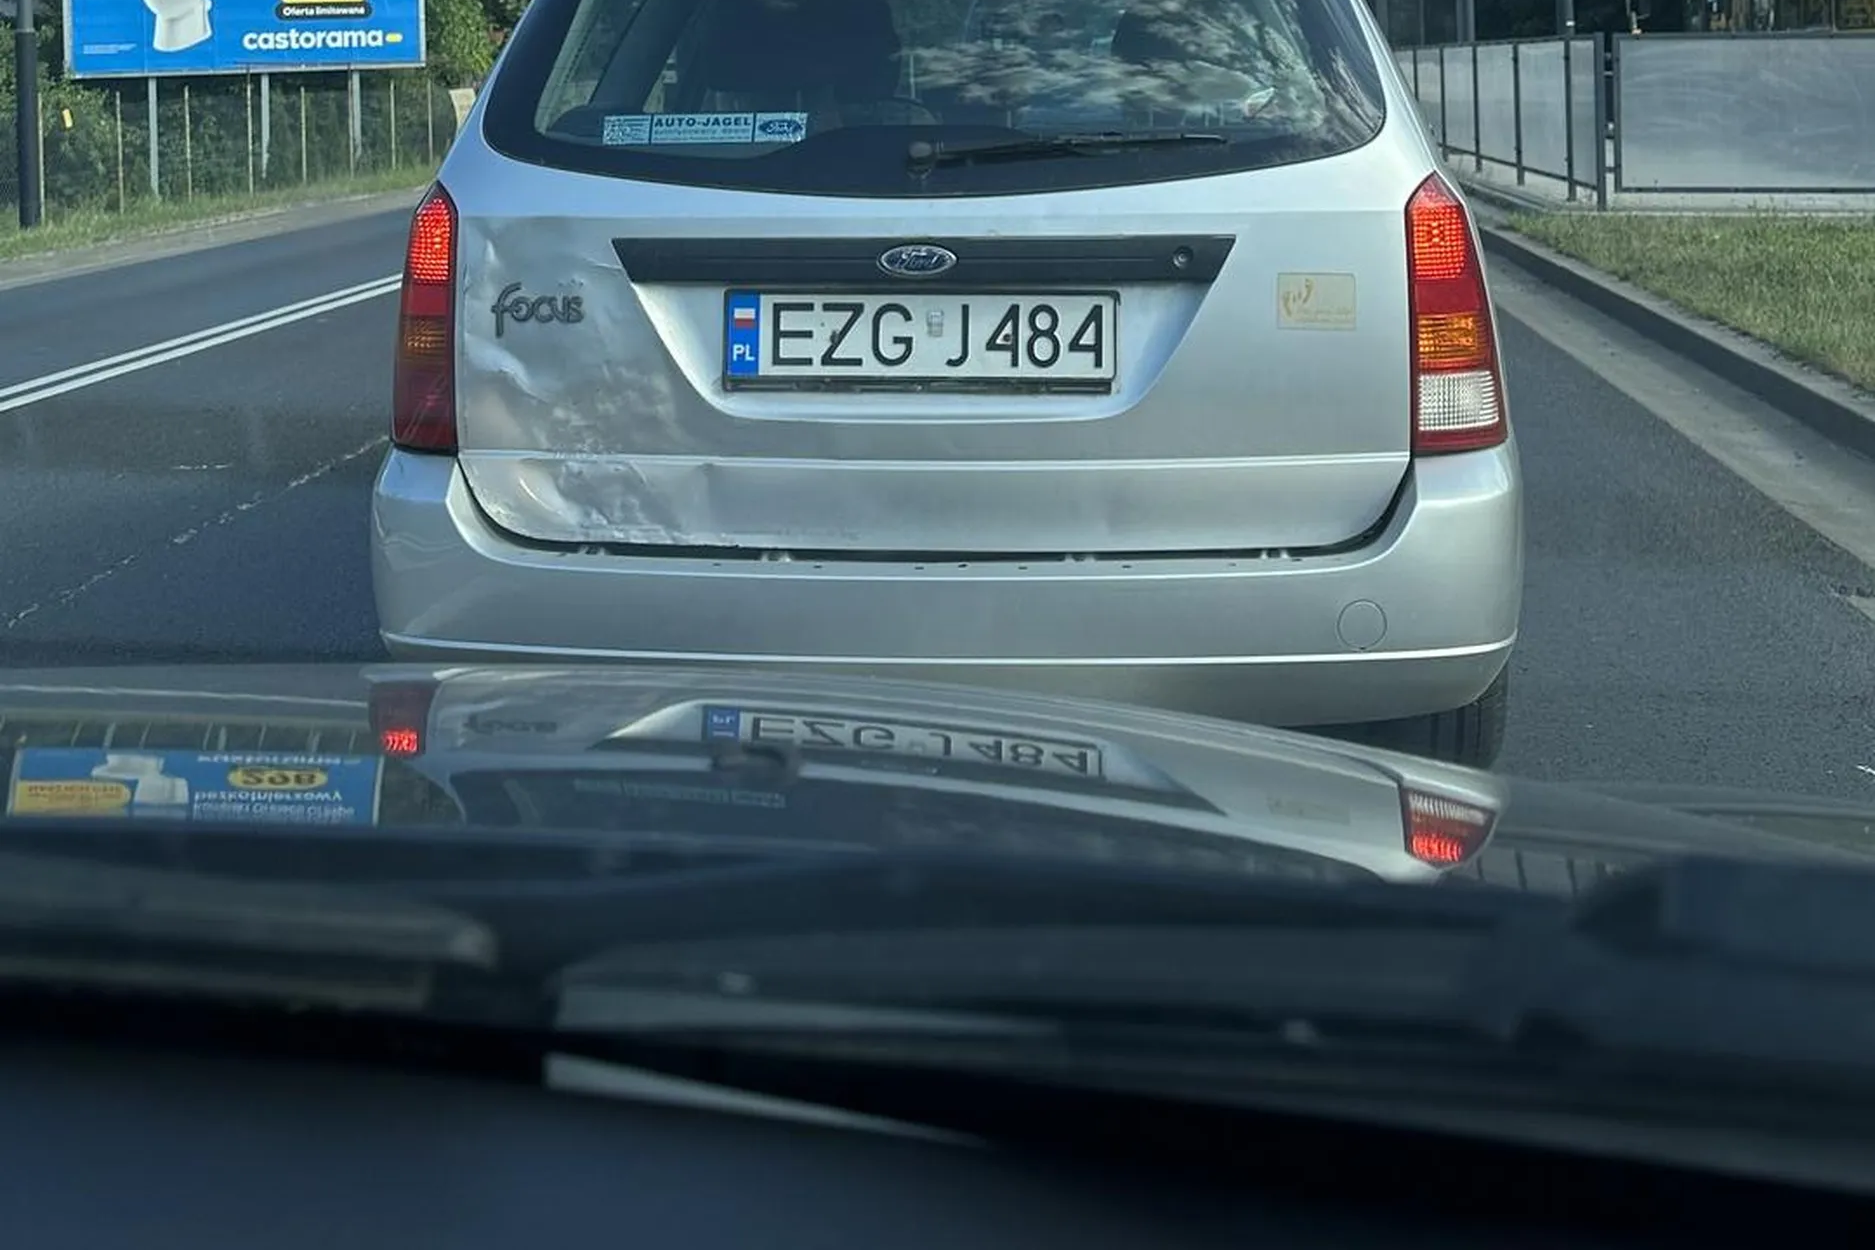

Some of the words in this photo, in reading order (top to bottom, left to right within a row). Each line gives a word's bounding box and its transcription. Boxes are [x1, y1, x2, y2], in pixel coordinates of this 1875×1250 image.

[282, 5, 315, 17] Oferta
[242, 28, 384, 50] castorama
[653, 116, 752, 129] AUTO-JAGEL
[771, 302, 914, 367] EZG
[944, 303, 1104, 368] J484
[732, 344, 755, 361] PL
